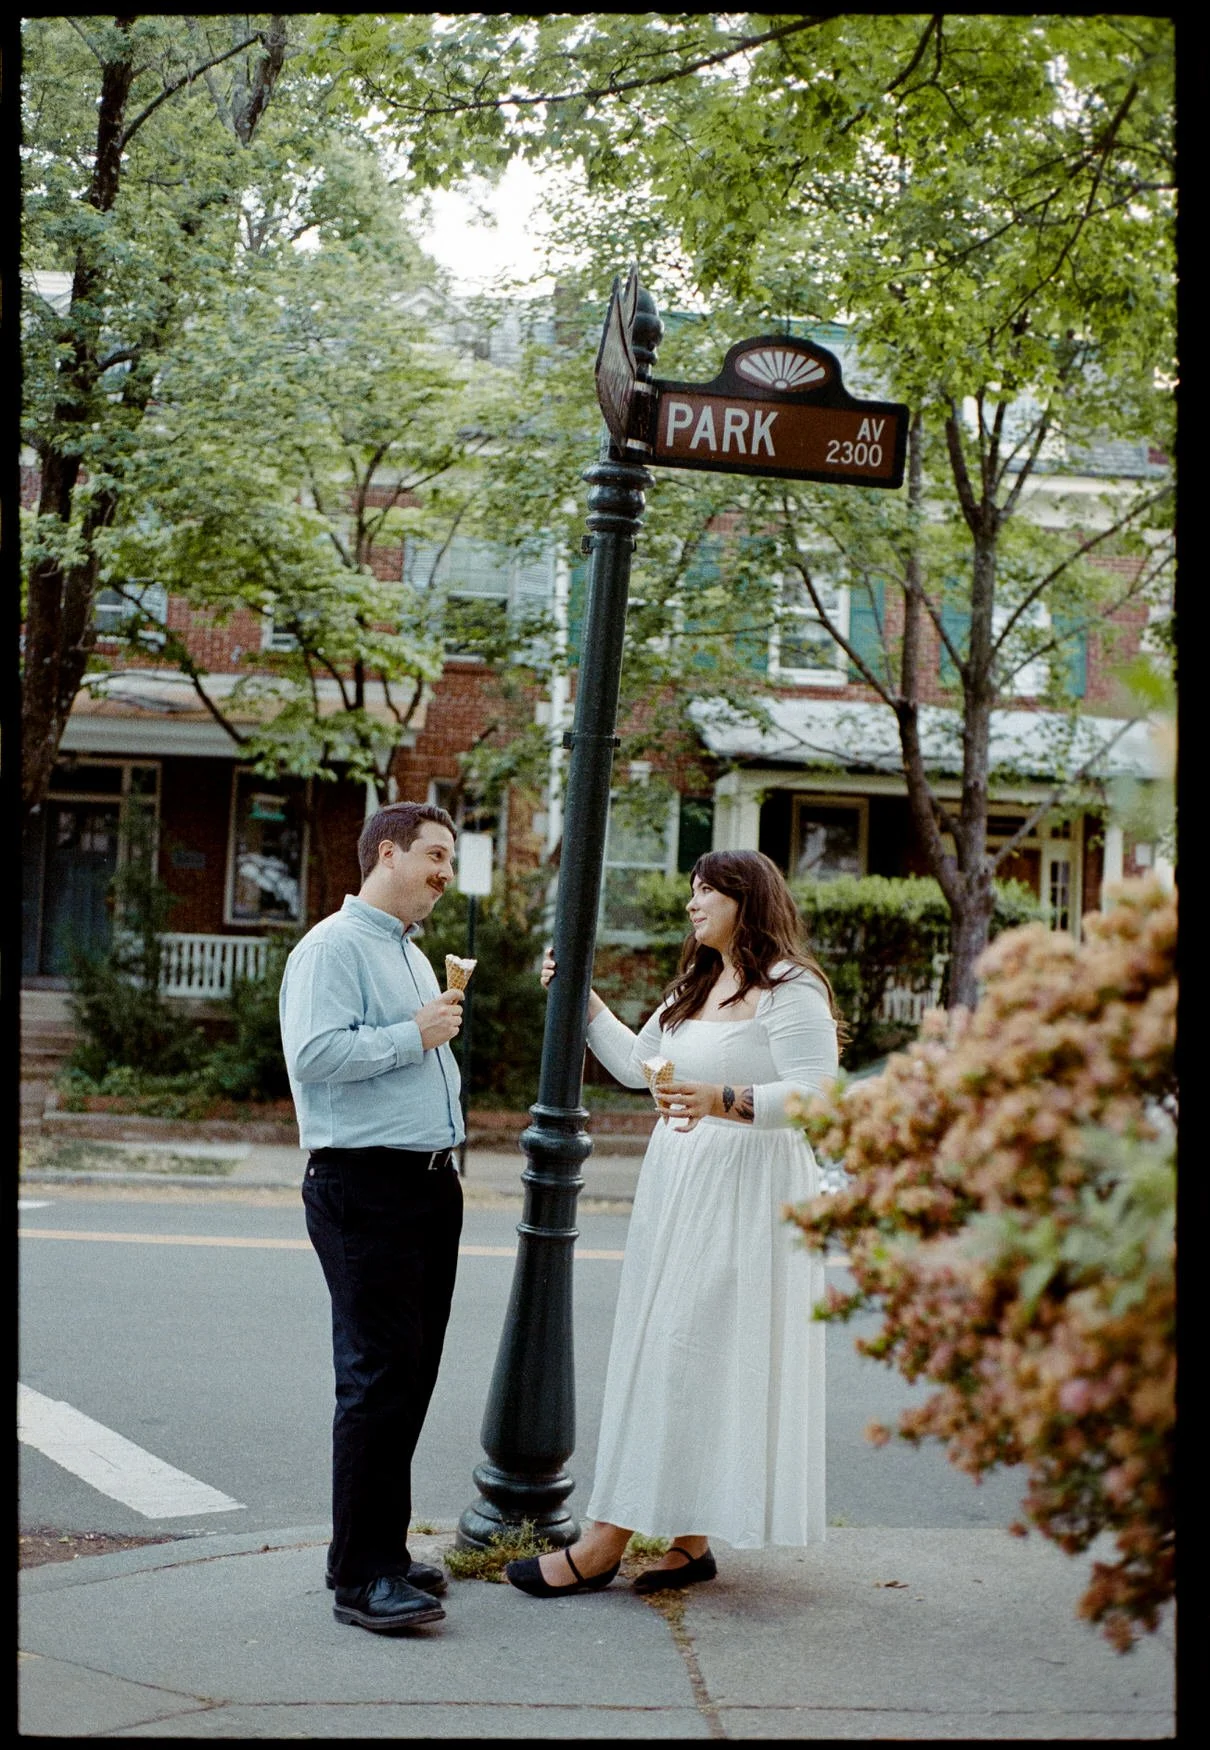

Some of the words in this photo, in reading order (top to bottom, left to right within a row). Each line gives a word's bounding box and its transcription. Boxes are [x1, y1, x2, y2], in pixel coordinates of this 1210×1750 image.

[666, 402, 779, 456] PARK
[857, 418, 885, 441] AV
[826, 440, 882, 467] 2300
